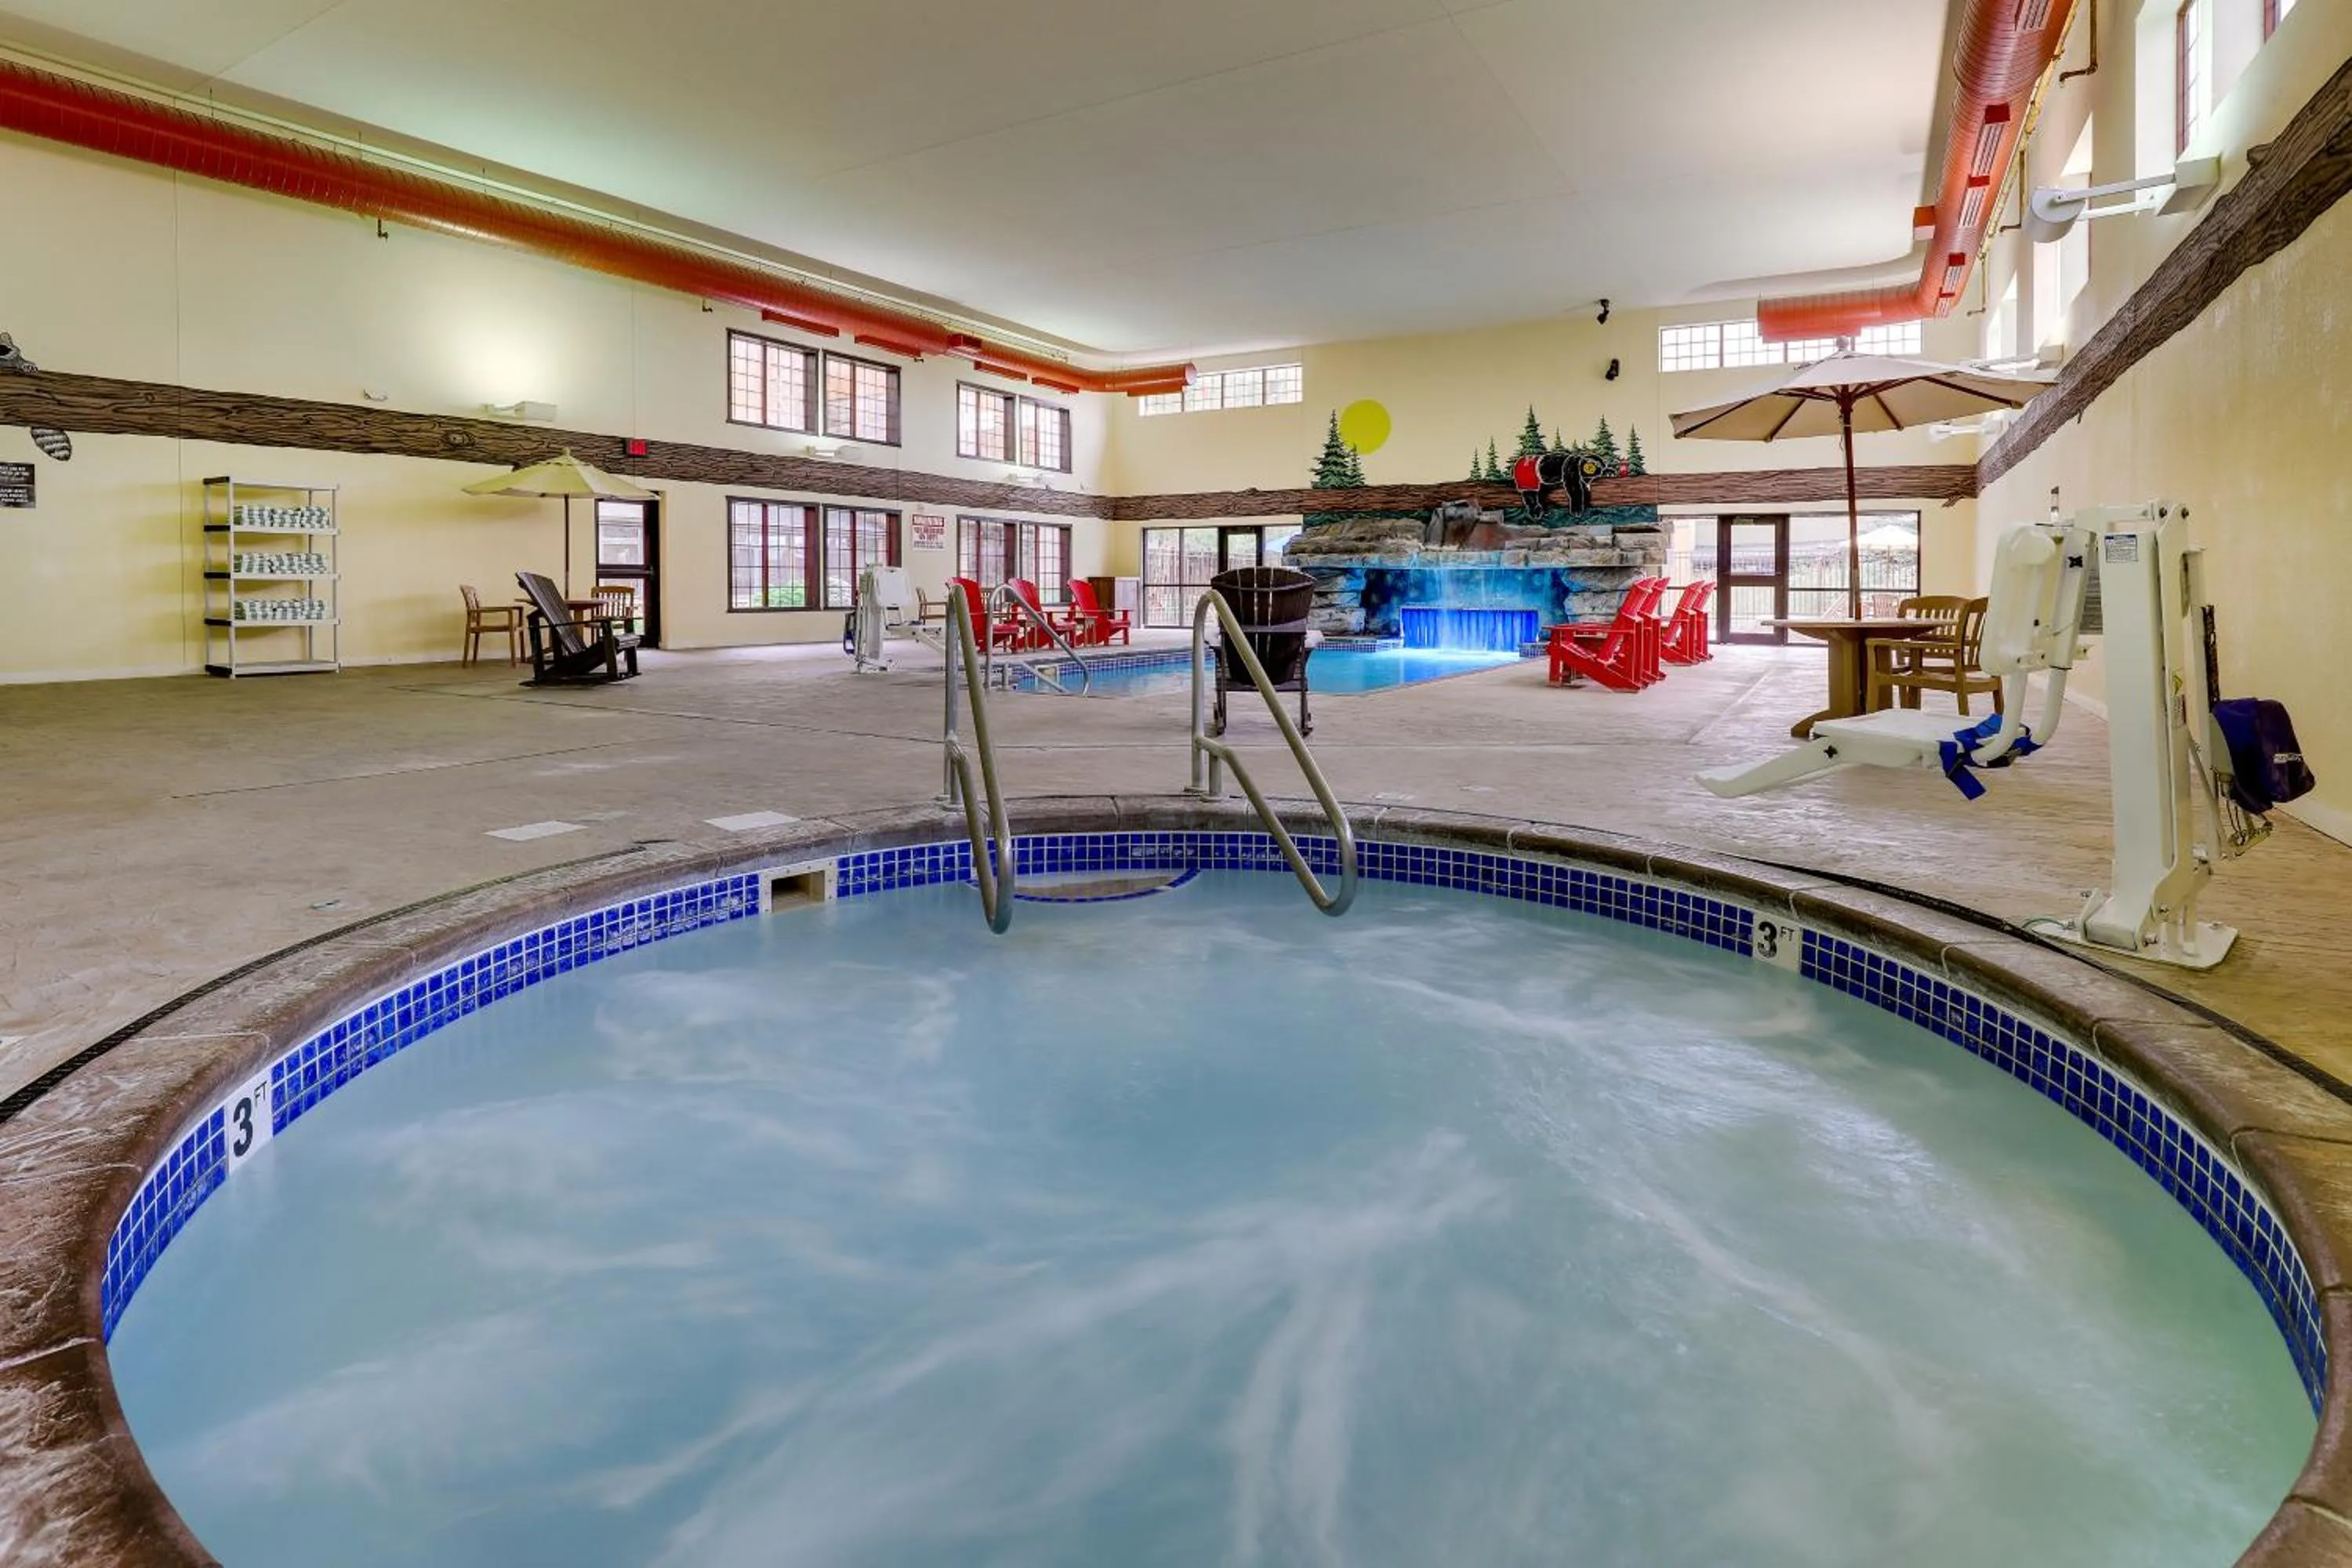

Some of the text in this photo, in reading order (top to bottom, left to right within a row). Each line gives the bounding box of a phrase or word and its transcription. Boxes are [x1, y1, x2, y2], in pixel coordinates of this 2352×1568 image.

[1757, 921, 1795, 958] 3 FT
[234, 1081, 267, 1157] 3 FT
